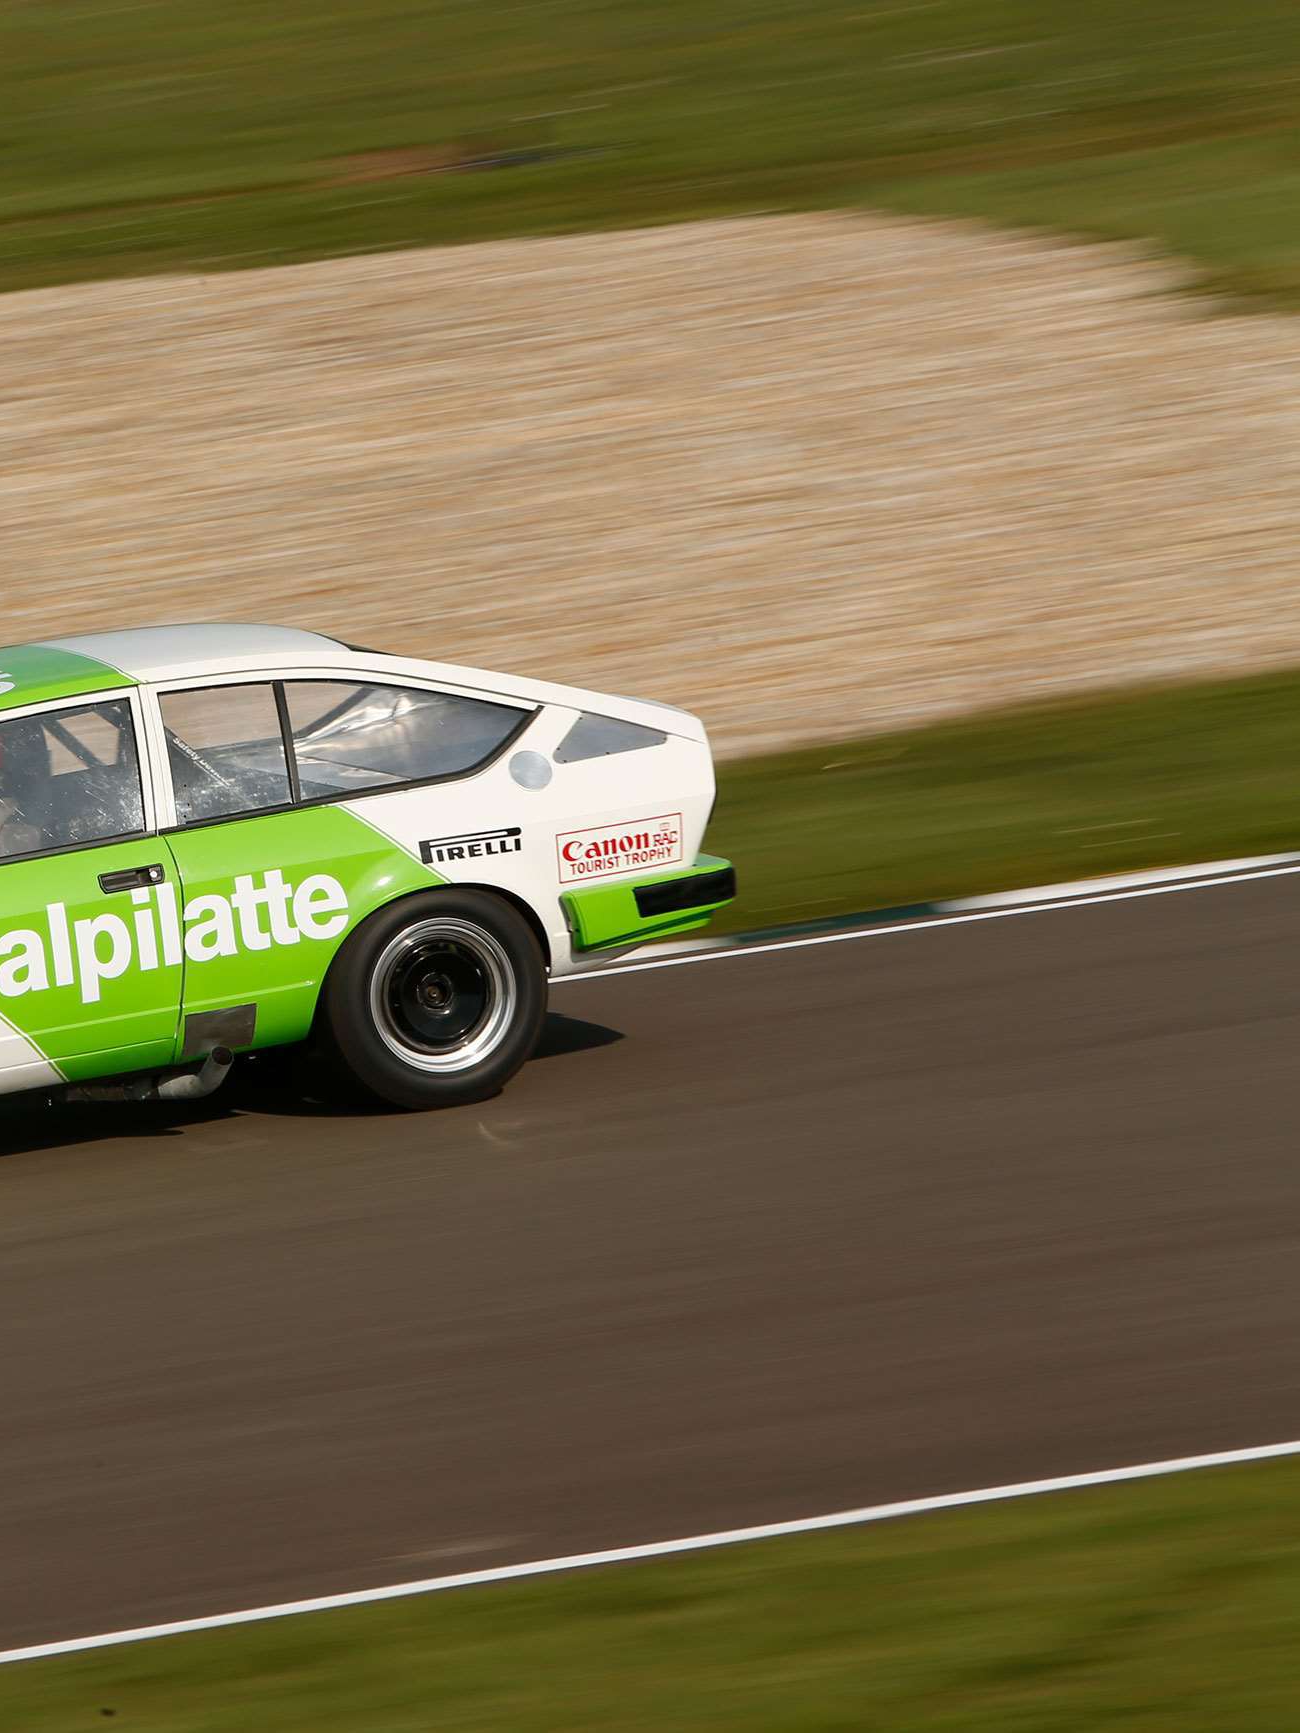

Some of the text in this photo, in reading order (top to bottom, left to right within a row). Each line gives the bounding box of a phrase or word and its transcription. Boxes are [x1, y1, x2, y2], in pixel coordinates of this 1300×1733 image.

[173, 738, 201, 760] Safety
[419, 827, 521, 863] PIRELLI
[562, 830, 678, 862] Canon RAC
[570, 847, 673, 875] TOURIST TROPHY
